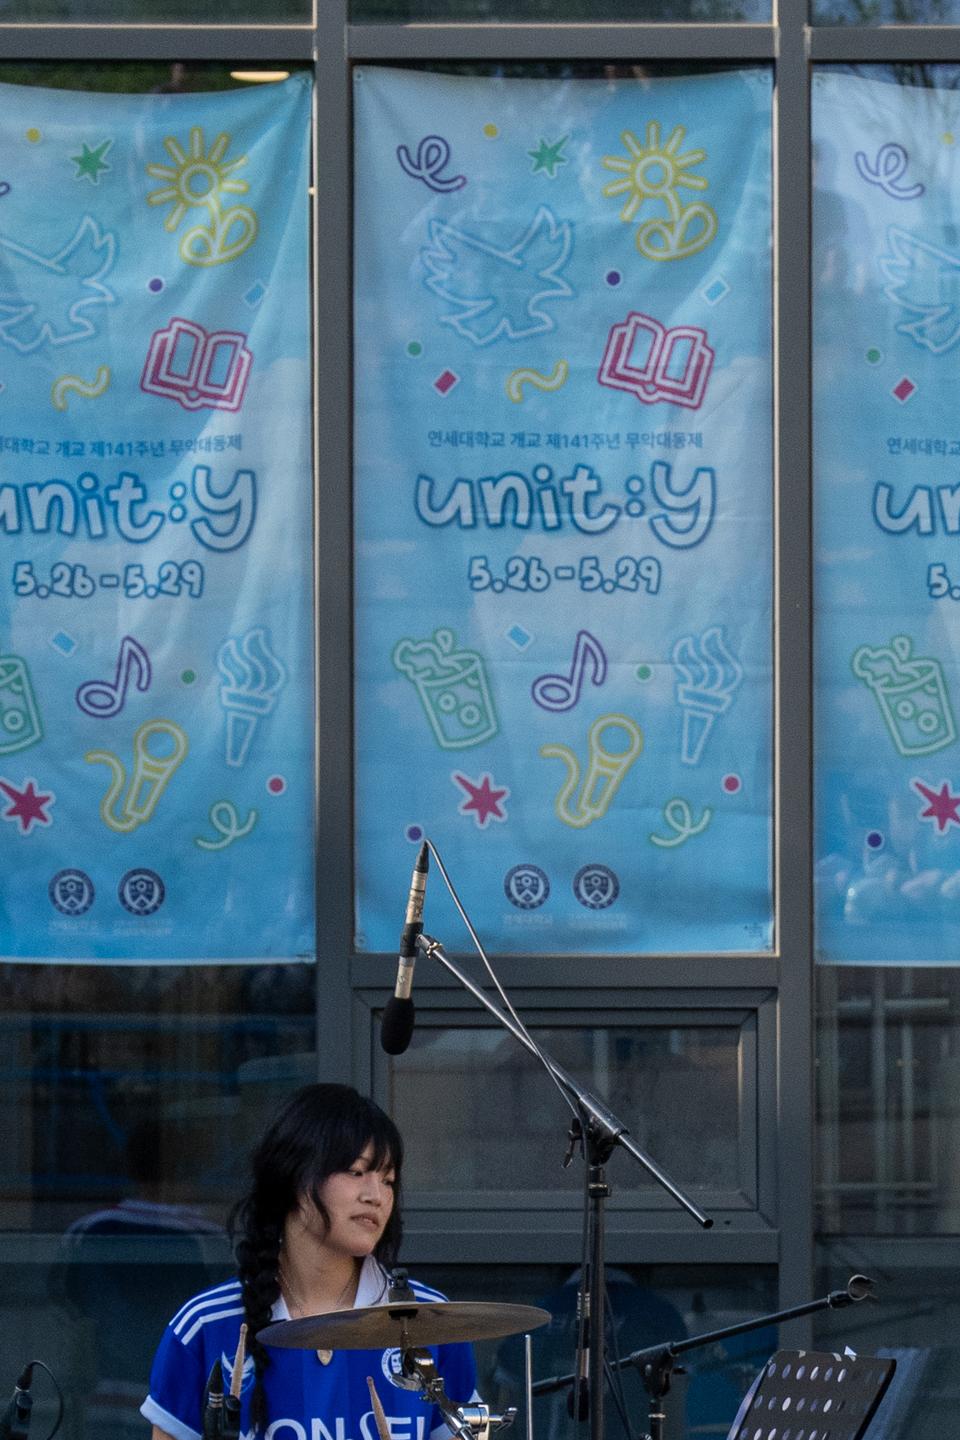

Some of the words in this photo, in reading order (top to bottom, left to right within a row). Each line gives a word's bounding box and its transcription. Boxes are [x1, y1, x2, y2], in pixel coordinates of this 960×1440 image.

[55, 440, 85, 457] 개교
[91, 440, 165, 457] 제141주년
[427, 430, 505, 448] 연세대학교
[511, 431, 541, 448] 개교
[546, 431, 620, 450] 제141주년
[625, 431, 703, 450] 무악대동제
[414, 460, 717, 550] unit:y
